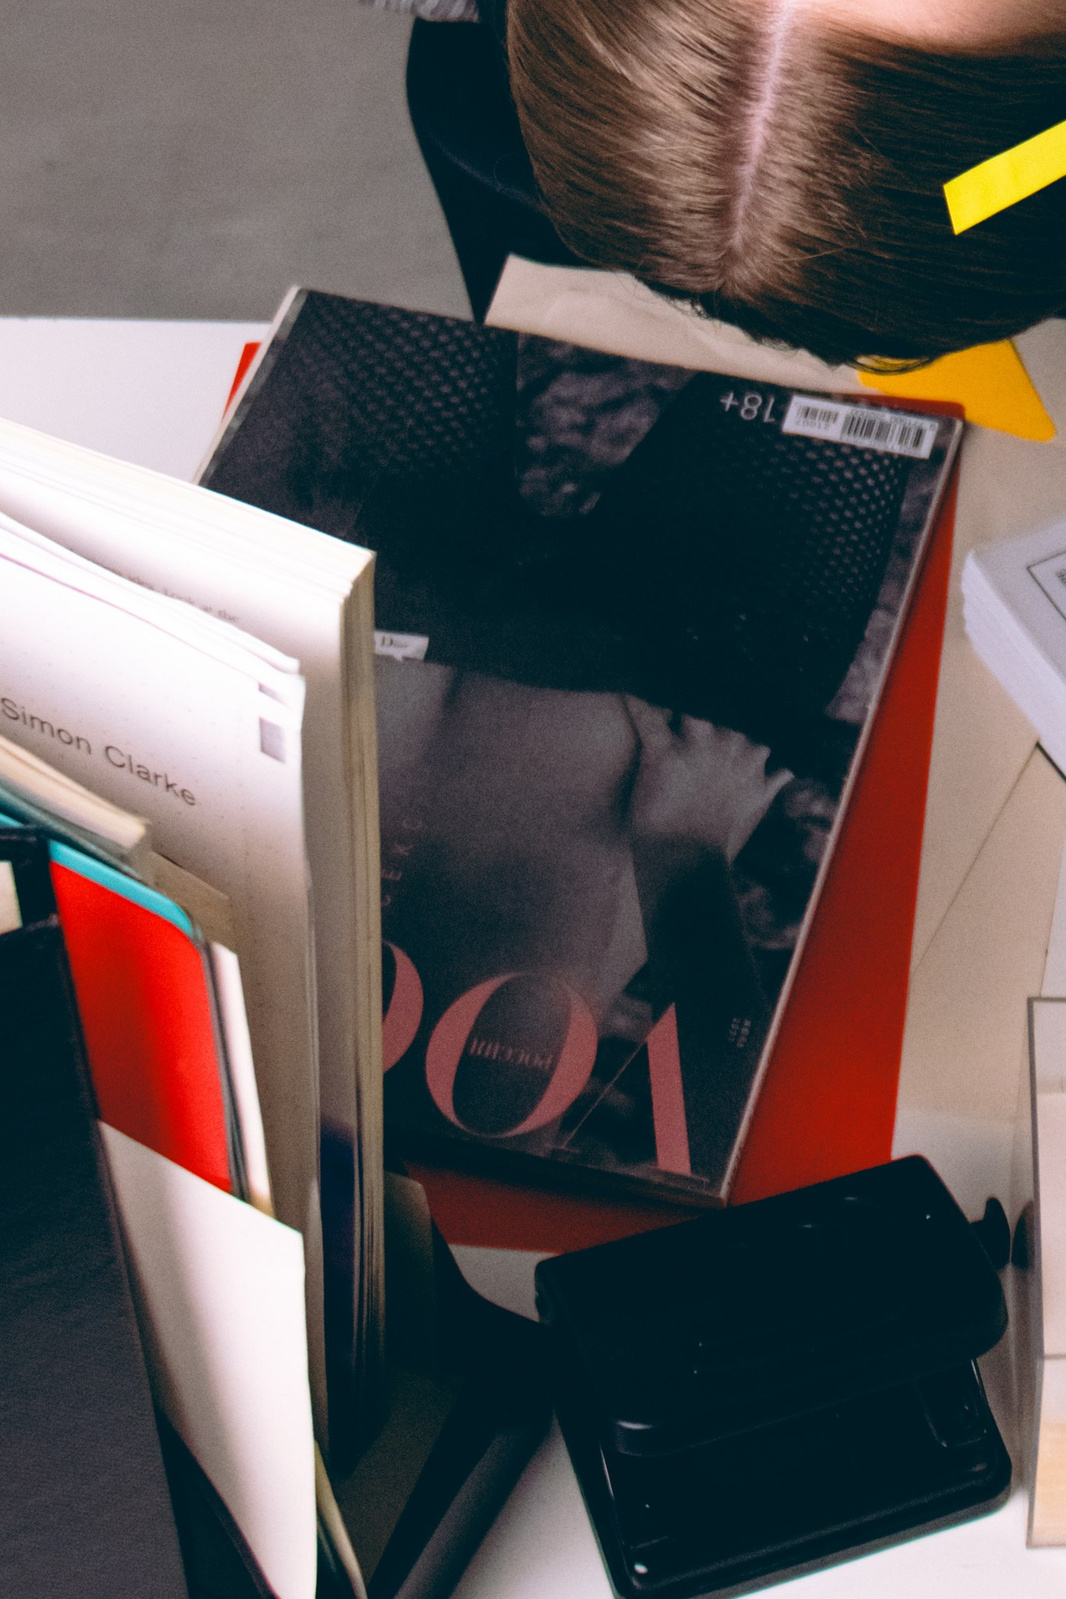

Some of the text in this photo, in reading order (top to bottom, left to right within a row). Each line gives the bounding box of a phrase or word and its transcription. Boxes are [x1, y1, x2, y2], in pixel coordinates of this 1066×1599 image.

[720, 391, 776, 423] 18+
[1, 698, 196, 807] Simon Clarke
